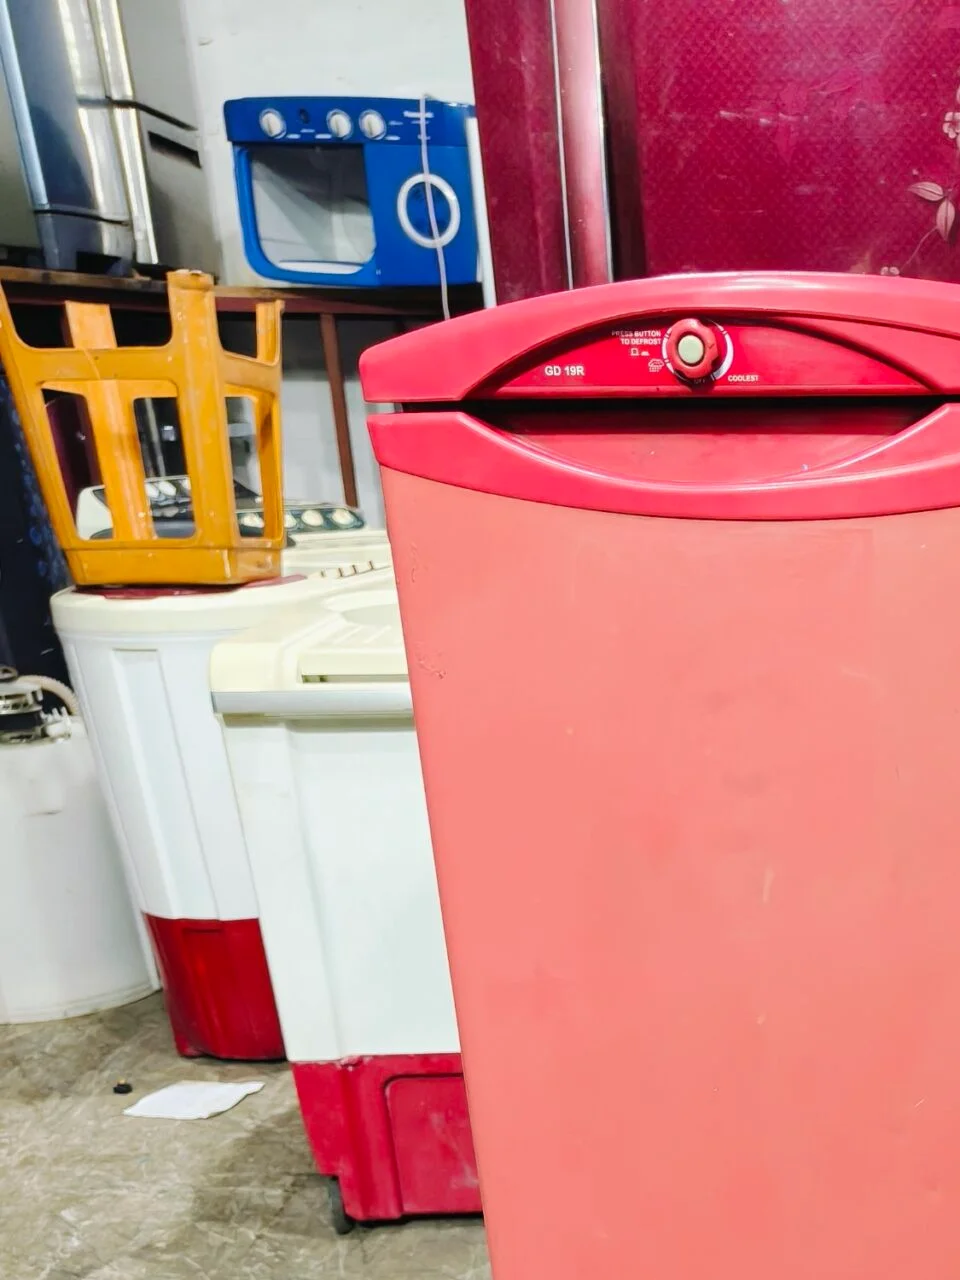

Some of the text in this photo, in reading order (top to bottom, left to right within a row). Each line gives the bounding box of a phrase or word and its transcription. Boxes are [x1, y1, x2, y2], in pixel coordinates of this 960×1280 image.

[544, 365, 585, 376] GD 19R
[727, 374, 759, 382] COOLEST
